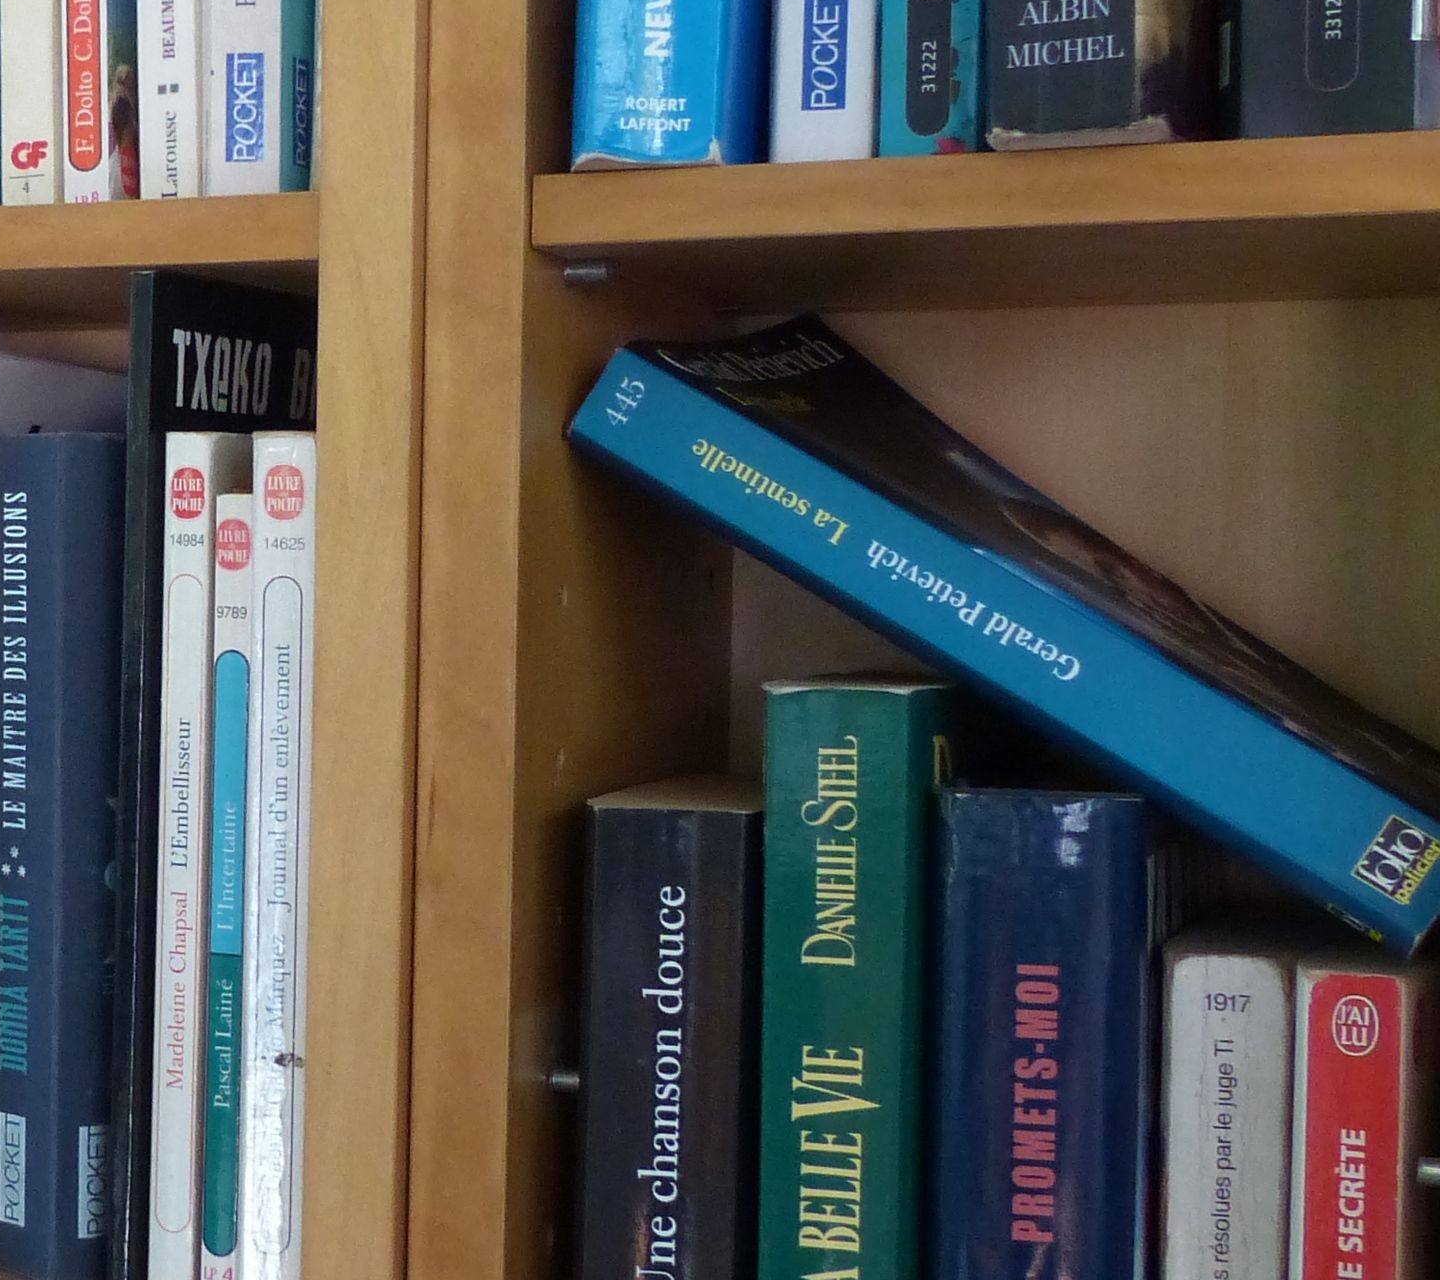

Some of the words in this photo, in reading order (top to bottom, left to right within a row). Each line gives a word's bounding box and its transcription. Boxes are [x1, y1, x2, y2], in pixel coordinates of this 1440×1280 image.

[1006, 34, 1125, 69] MICHEL
[688, 435, 814, 518] sentinelle
[2, 490, 29, 625] ILLUSIONS
[822, 514, 851, 546] La
[863, 538, 990, 626] Petievich
[3, 634, 28, 681] DES
[982, 612, 1081, 682] Gerald
[2, 691, 28, 790] MAITRE
[1, 799, 27, 830] LE
[801, 735, 861, 831] STEEL
[167, 890, 193, 974] Chapsal
[801, 837, 859, 966] DANIELLE
[642, 884, 687, 1014] douce
[165, 982, 187, 1091] Madeleine
[212, 978, 234, 1039] Lainé
[1213, 1038, 1235, 1057] Ti
[212, 1045, 232, 1109] Pascal
[636, 1026, 684, 1203] chanson
[791, 1044, 883, 1121] VIE
[1011, 963, 1060, 1242] PROMETS-MOI
[1213, 1062, 1239, 1108] juge
[1212, 1112, 1233, 1131] le
[1215, 1135, 1239, 1171] par
[799, 1129, 864, 1252] BELLE
[1208, 1175, 1232, 1264] résolues
[1335, 1128, 1367, 1253] SECRÈTE
